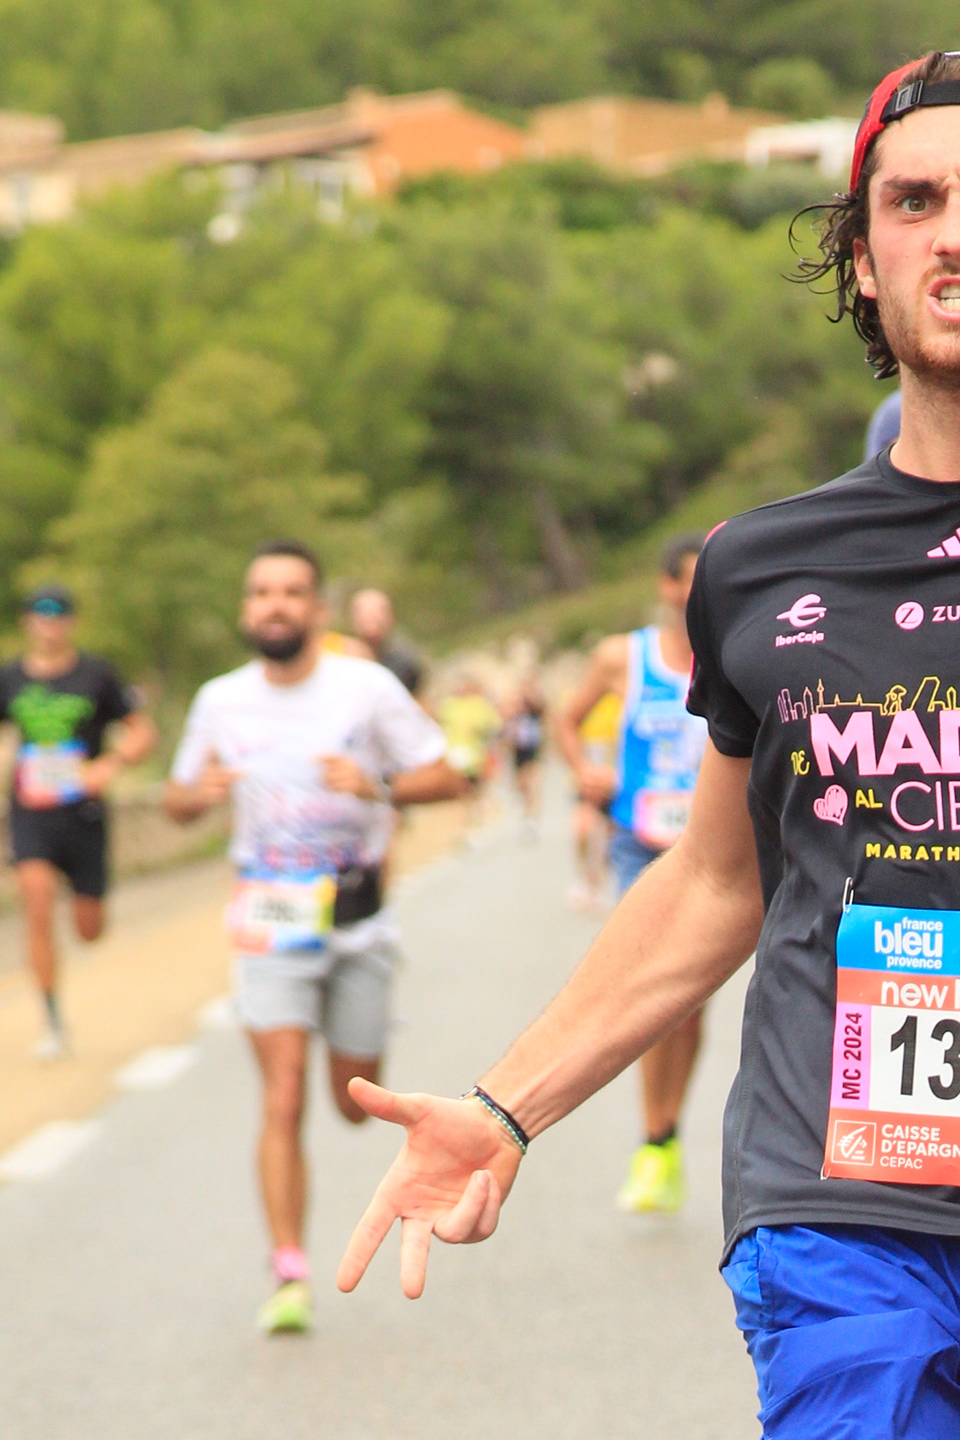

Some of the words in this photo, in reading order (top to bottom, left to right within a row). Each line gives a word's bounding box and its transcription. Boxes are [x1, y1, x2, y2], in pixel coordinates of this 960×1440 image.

[775, 630, 825, 647] IberCaja
[790, 750, 811, 776] DE
[855, 789, 883, 808] AL
[902, 917, 943, 931] france
[874, 921, 943, 957] bleu
[887, 956, 943, 969] provence
[881, 980, 948, 1006] new
[843, 1012, 862, 1061] 2024
[842, 1069, 862, 1100] MC
[881, 1124, 940, 1142] CAISSE
[880, 1156, 923, 1170] CEPAC
